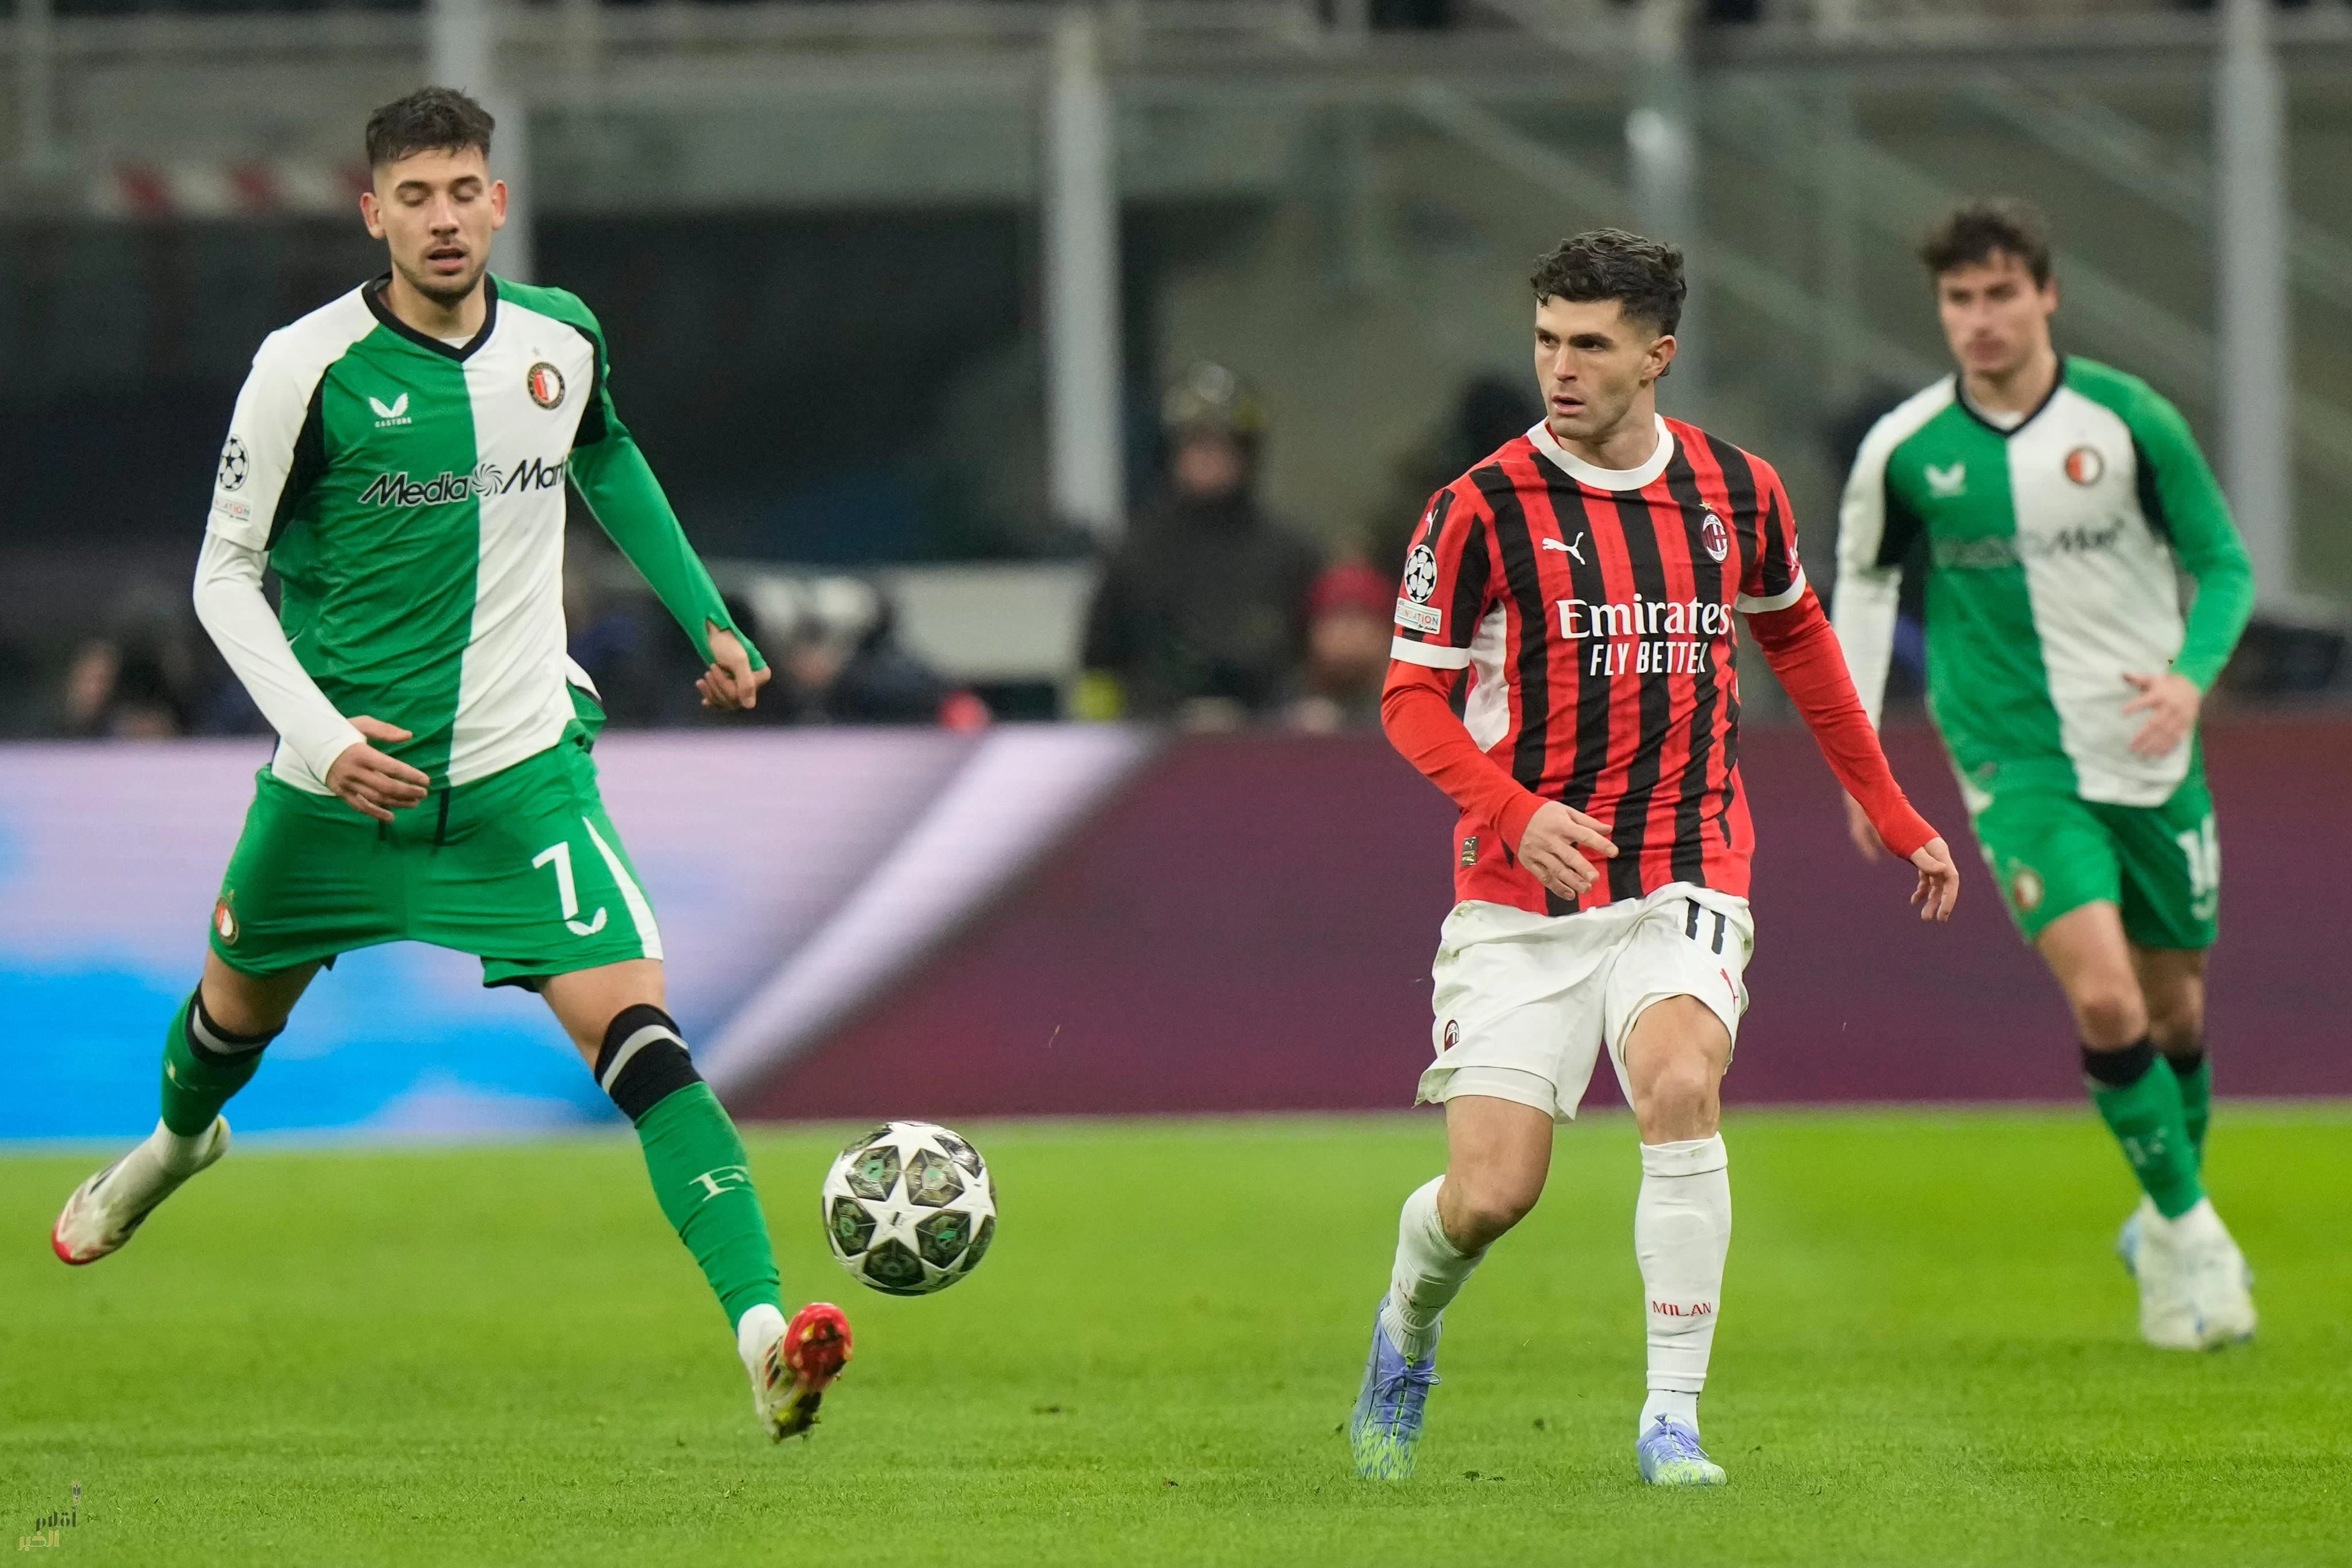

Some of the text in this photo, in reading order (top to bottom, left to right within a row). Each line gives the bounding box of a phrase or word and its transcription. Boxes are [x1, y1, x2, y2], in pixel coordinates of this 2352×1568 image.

[359, 471, 472, 507] Media
[1556, 593, 1731, 638] Emirates
[1589, 641, 1709, 676] FLY BETTER
[532, 841, 579, 920] 7
[1685, 896, 1726, 955] 11
[1652, 1300, 1711, 1317] MILAN
